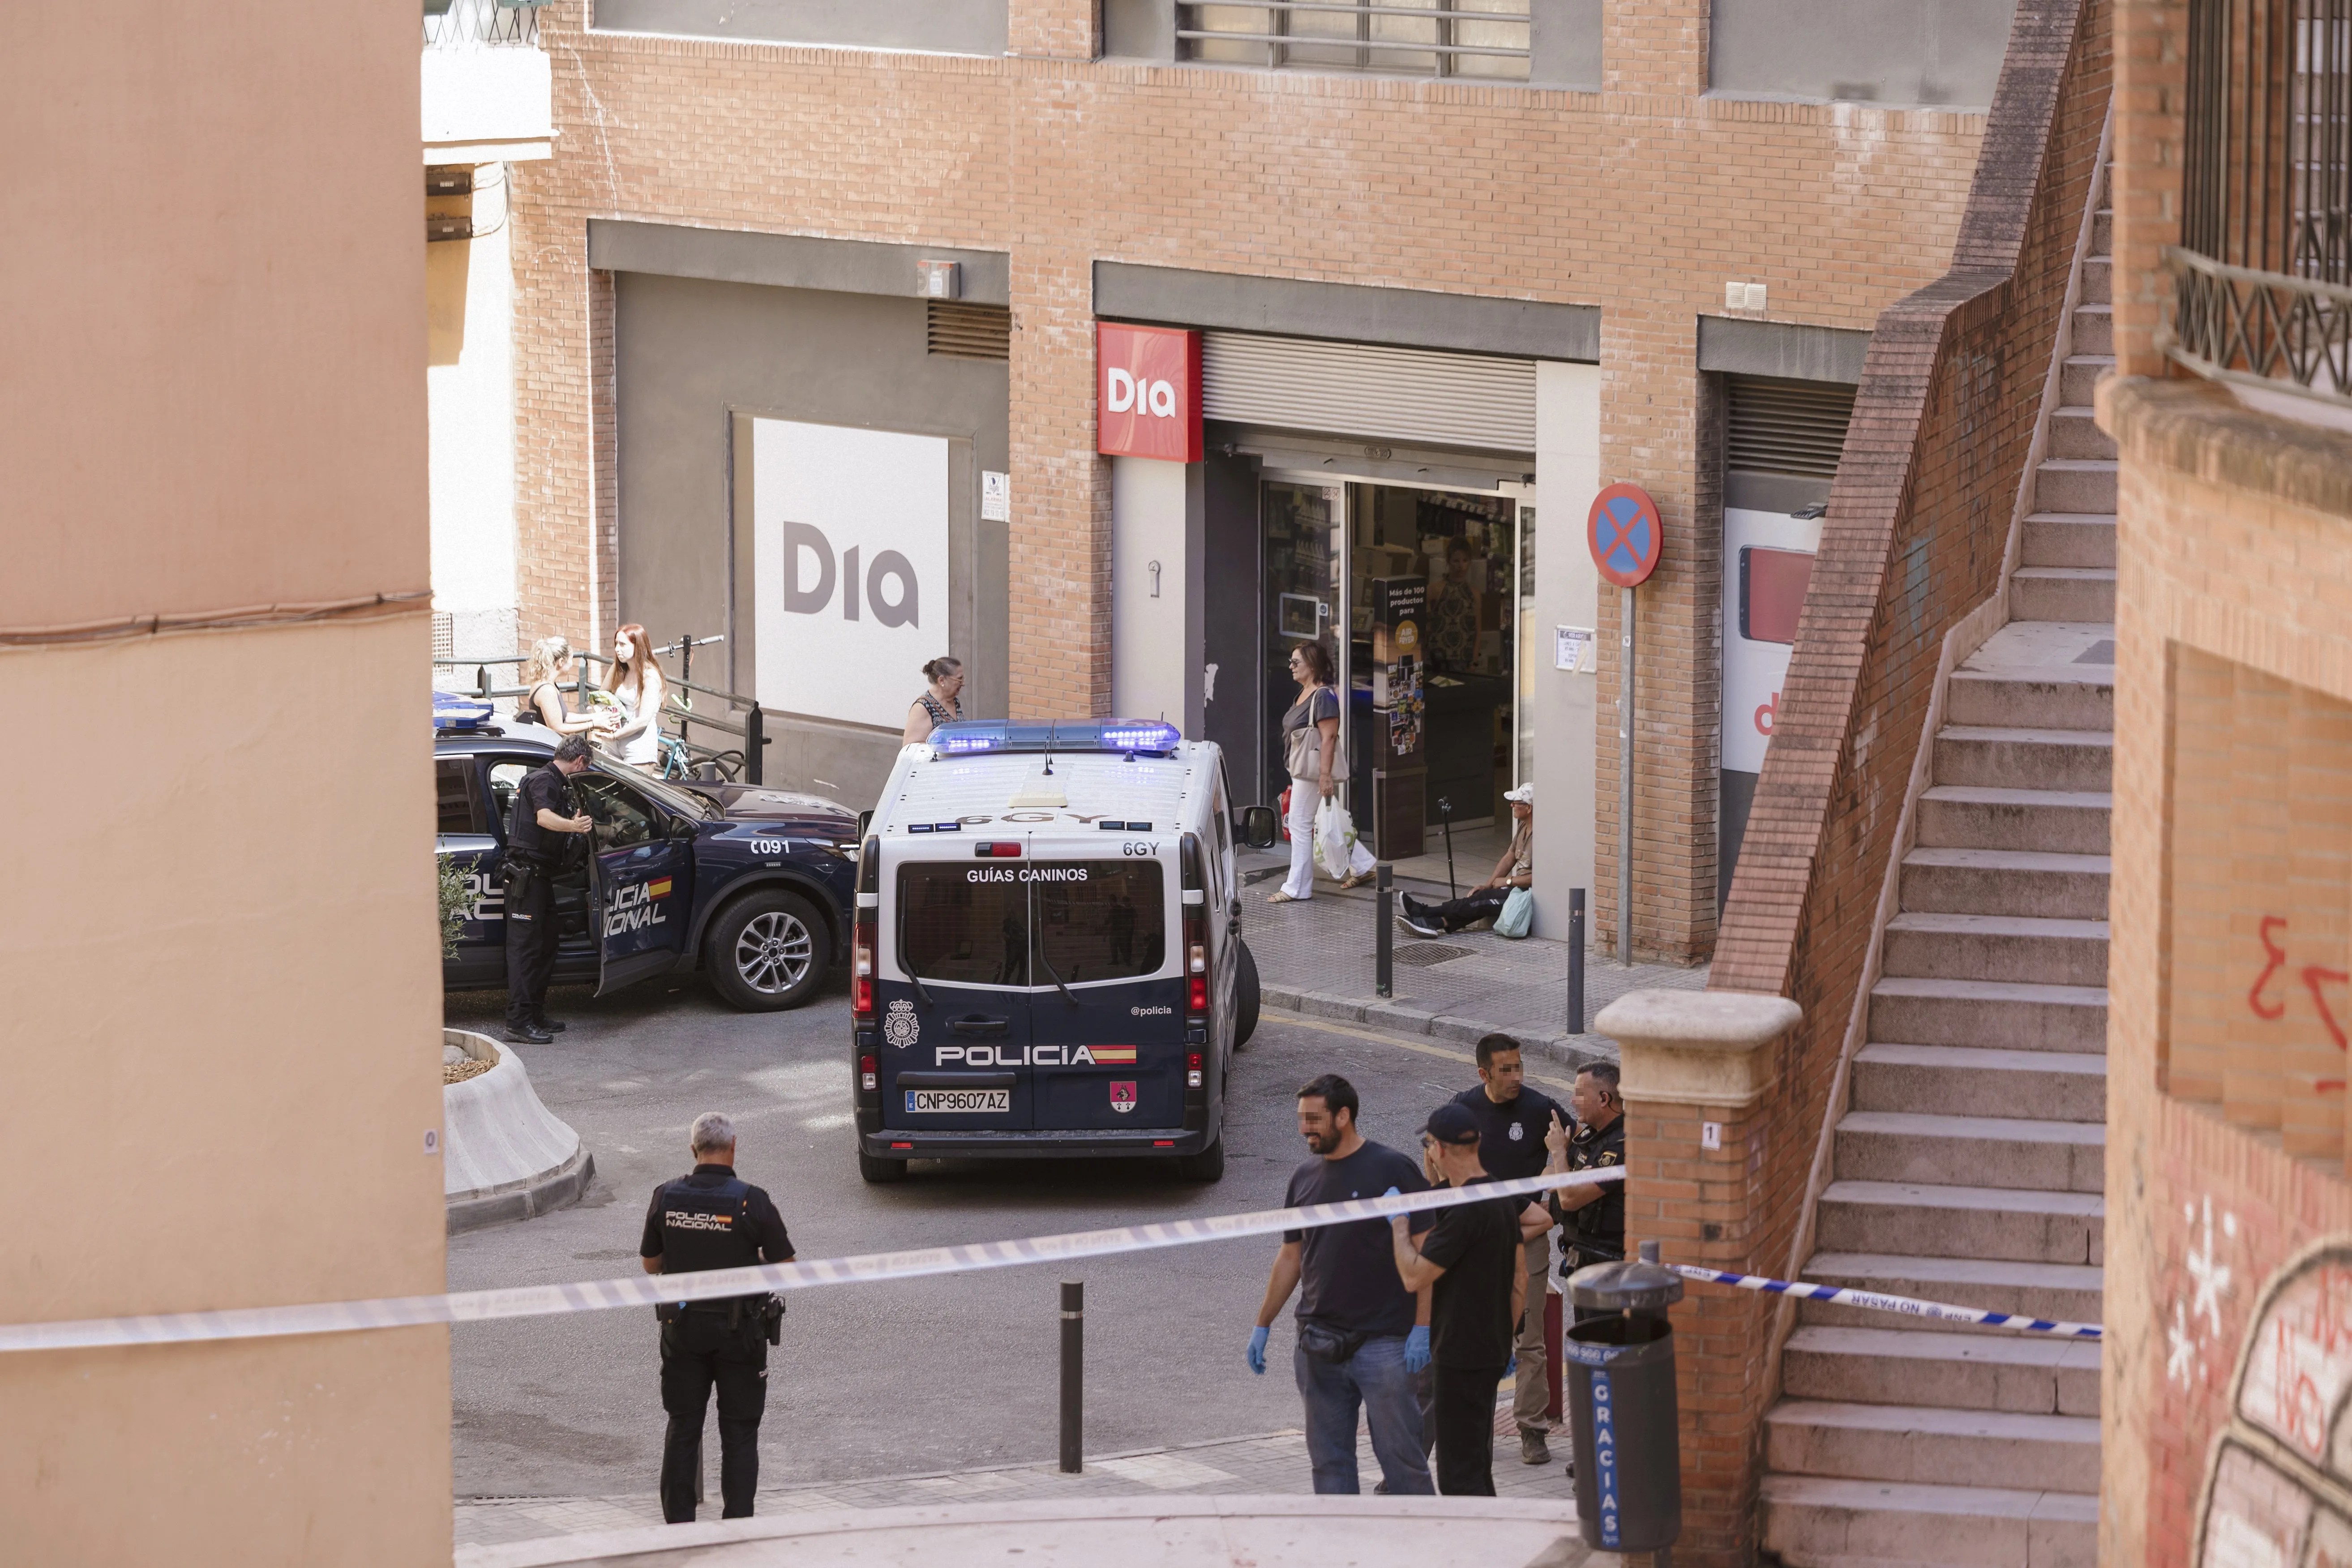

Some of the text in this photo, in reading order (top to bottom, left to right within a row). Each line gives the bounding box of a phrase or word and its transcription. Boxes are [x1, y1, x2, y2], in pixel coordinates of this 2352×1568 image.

[1389, 588, 1403, 597] Más
[1390, 597, 1423, 608] productos
[1399, 608, 1414, 616] para
[1401, 628, 1412, 636] AIR
[1399, 636, 1414, 644] FRYER
[955, 812, 1113, 825] 6GY
[760, 840, 789, 854] 091
[1123, 842, 1160, 856] 6GY
[967, 867, 1088, 883] GUÍAS CANINOS
[1131, 1006, 1172, 1017] @policia
[917, 1092, 1007, 1109] CNP9607AZ
[1705, 1126, 1712, 1140] 1
[666, 1219, 732, 1231] NACIONAL
[1851, 1294, 1897, 1311] PASAR
[1900, 1301, 1920, 1315] NO
[1594, 1384, 1618, 1532] GRACIAS
